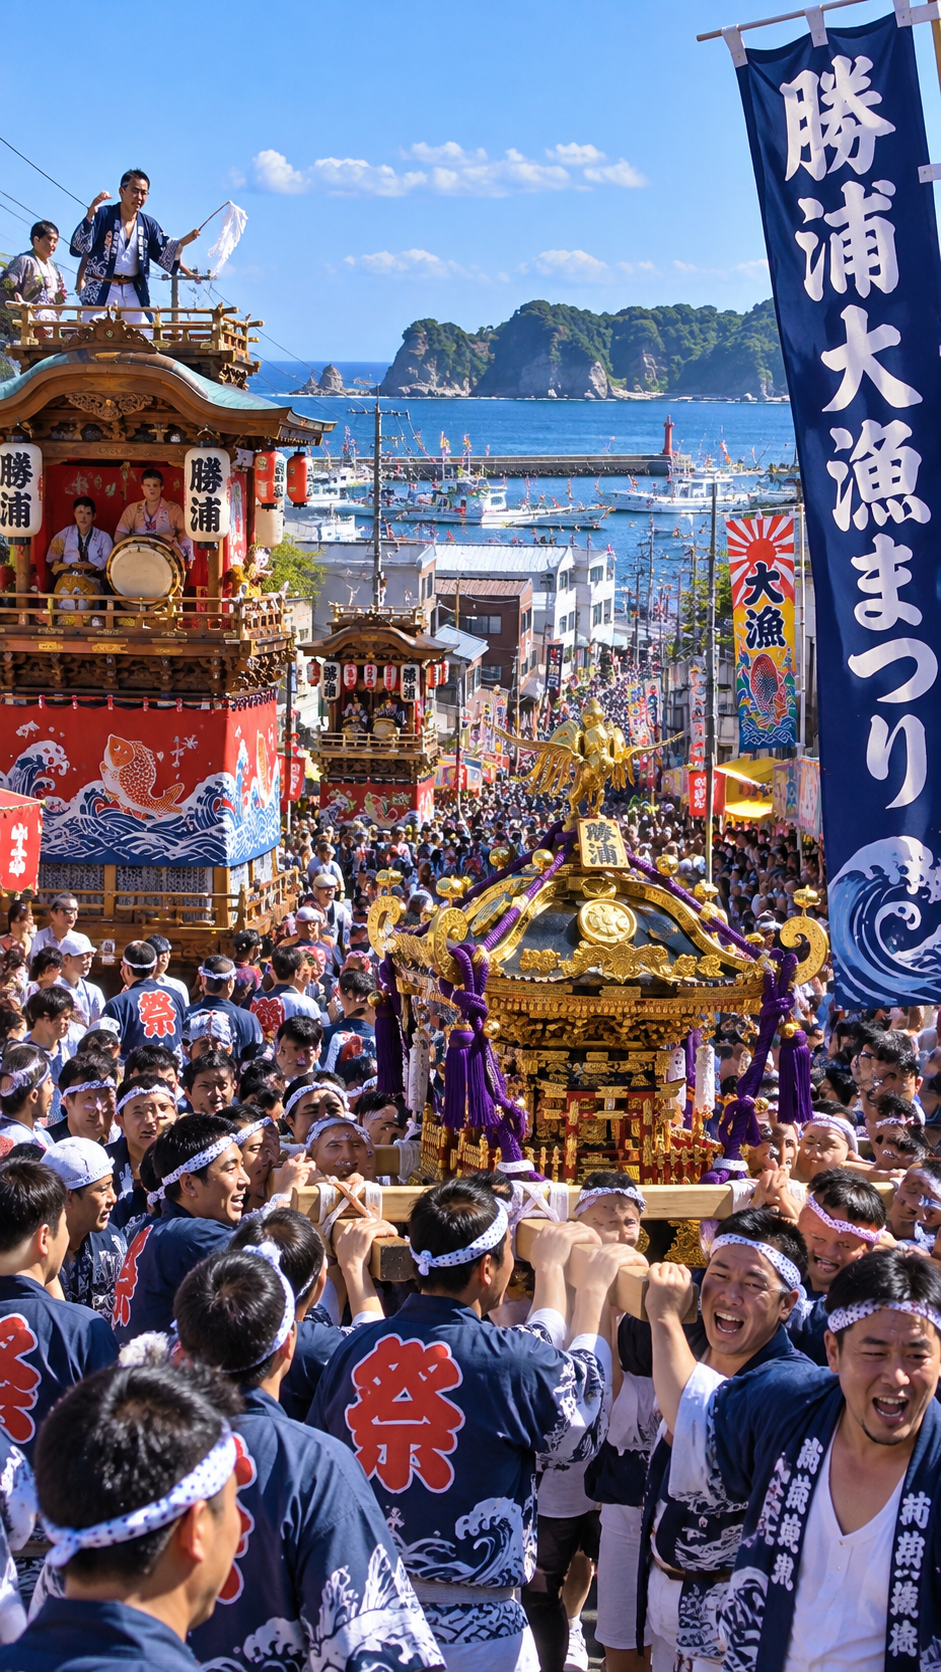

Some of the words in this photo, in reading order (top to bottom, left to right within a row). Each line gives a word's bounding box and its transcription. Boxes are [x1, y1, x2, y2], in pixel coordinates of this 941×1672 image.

[779, 54, 939, 810] 勝浦大漁まつり
[0, 452, 34, 529] 勝浦
[189, 457, 223, 533] 勝浦
[743, 561, 786, 649] 大漁
[584, 821, 618, 866] 勝浦
[138, 989, 177, 1039] 祭
[344, 1332, 466, 1495] 祭
